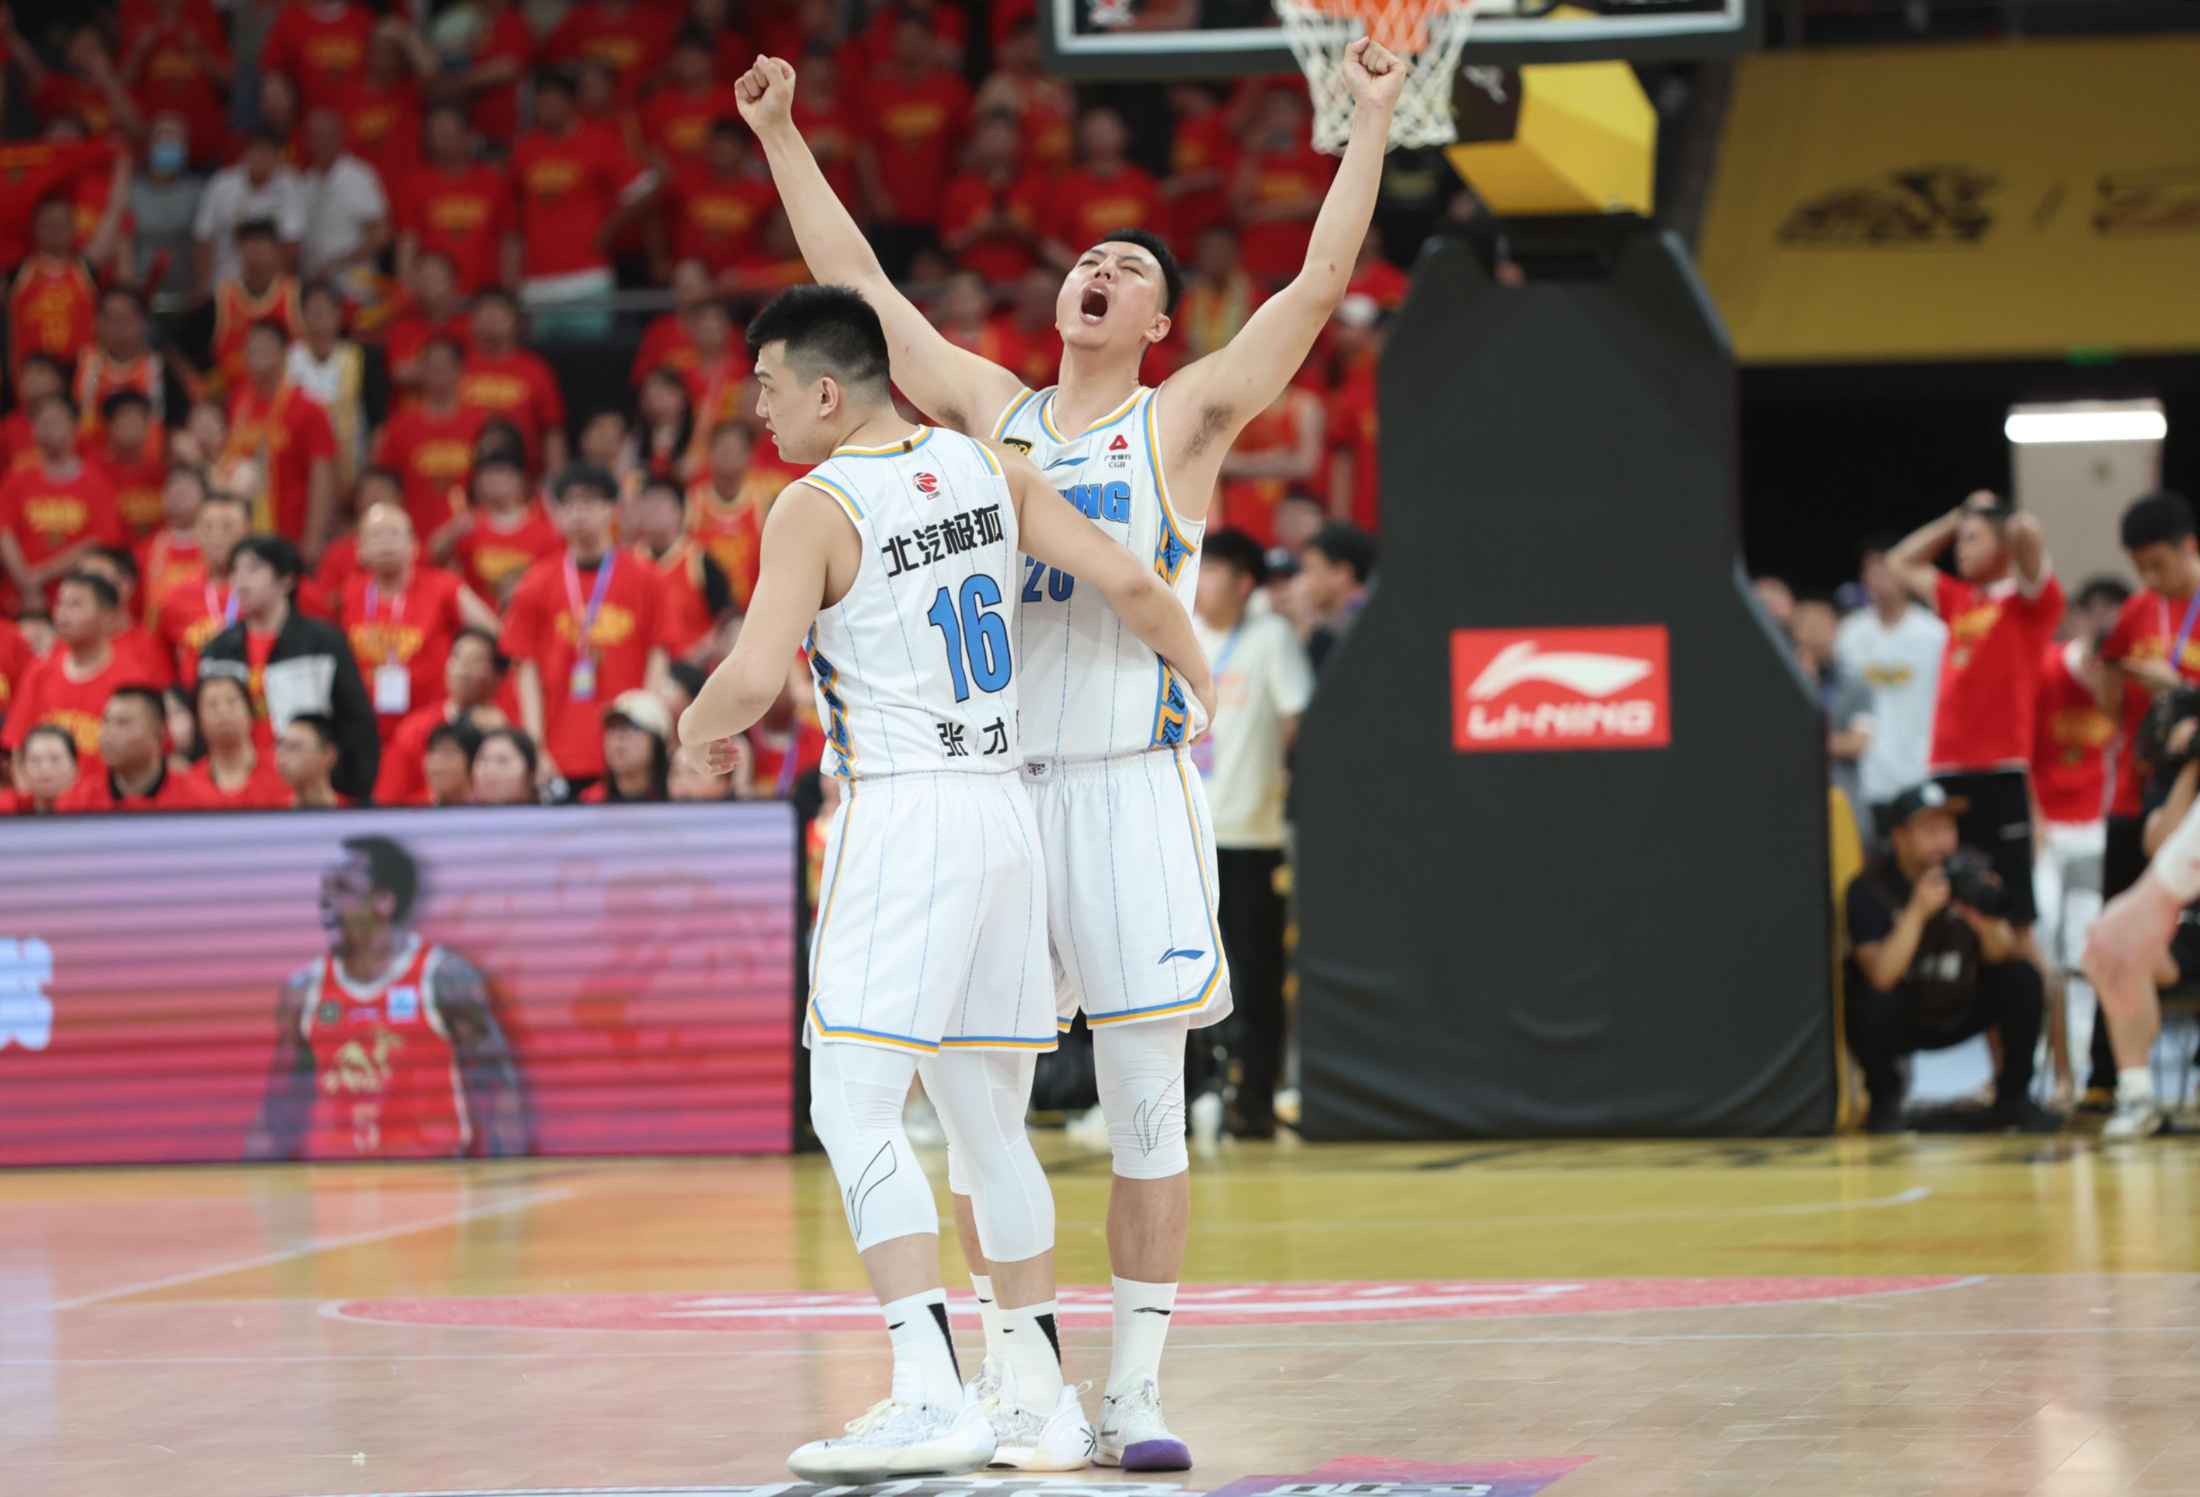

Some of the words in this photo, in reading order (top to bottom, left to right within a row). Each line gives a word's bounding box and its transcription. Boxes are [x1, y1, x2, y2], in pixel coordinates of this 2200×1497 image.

[1058, 481, 1131, 524] NG
[881, 503, 1004, 578] 北汽极狐
[926, 573, 1012, 704] 16
[936, 709, 1019, 758] 张才
